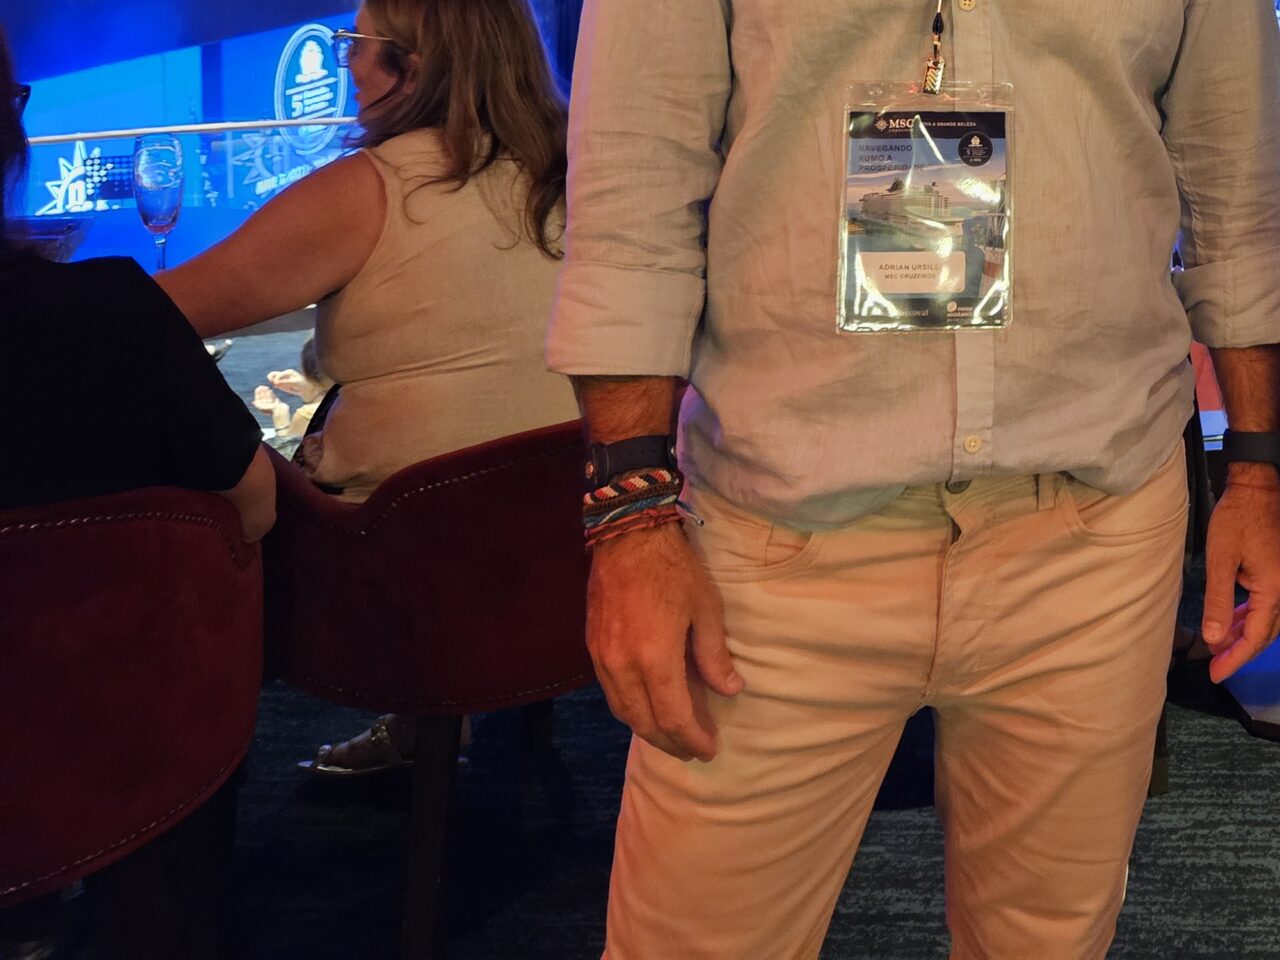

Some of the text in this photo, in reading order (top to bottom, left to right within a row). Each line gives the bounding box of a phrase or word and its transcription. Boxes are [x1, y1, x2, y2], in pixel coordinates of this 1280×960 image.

[889, 118, 915, 129] MSC
[858, 144, 913, 152] NAVEGANDO
[879, 263, 910, 271] ADRIAN
